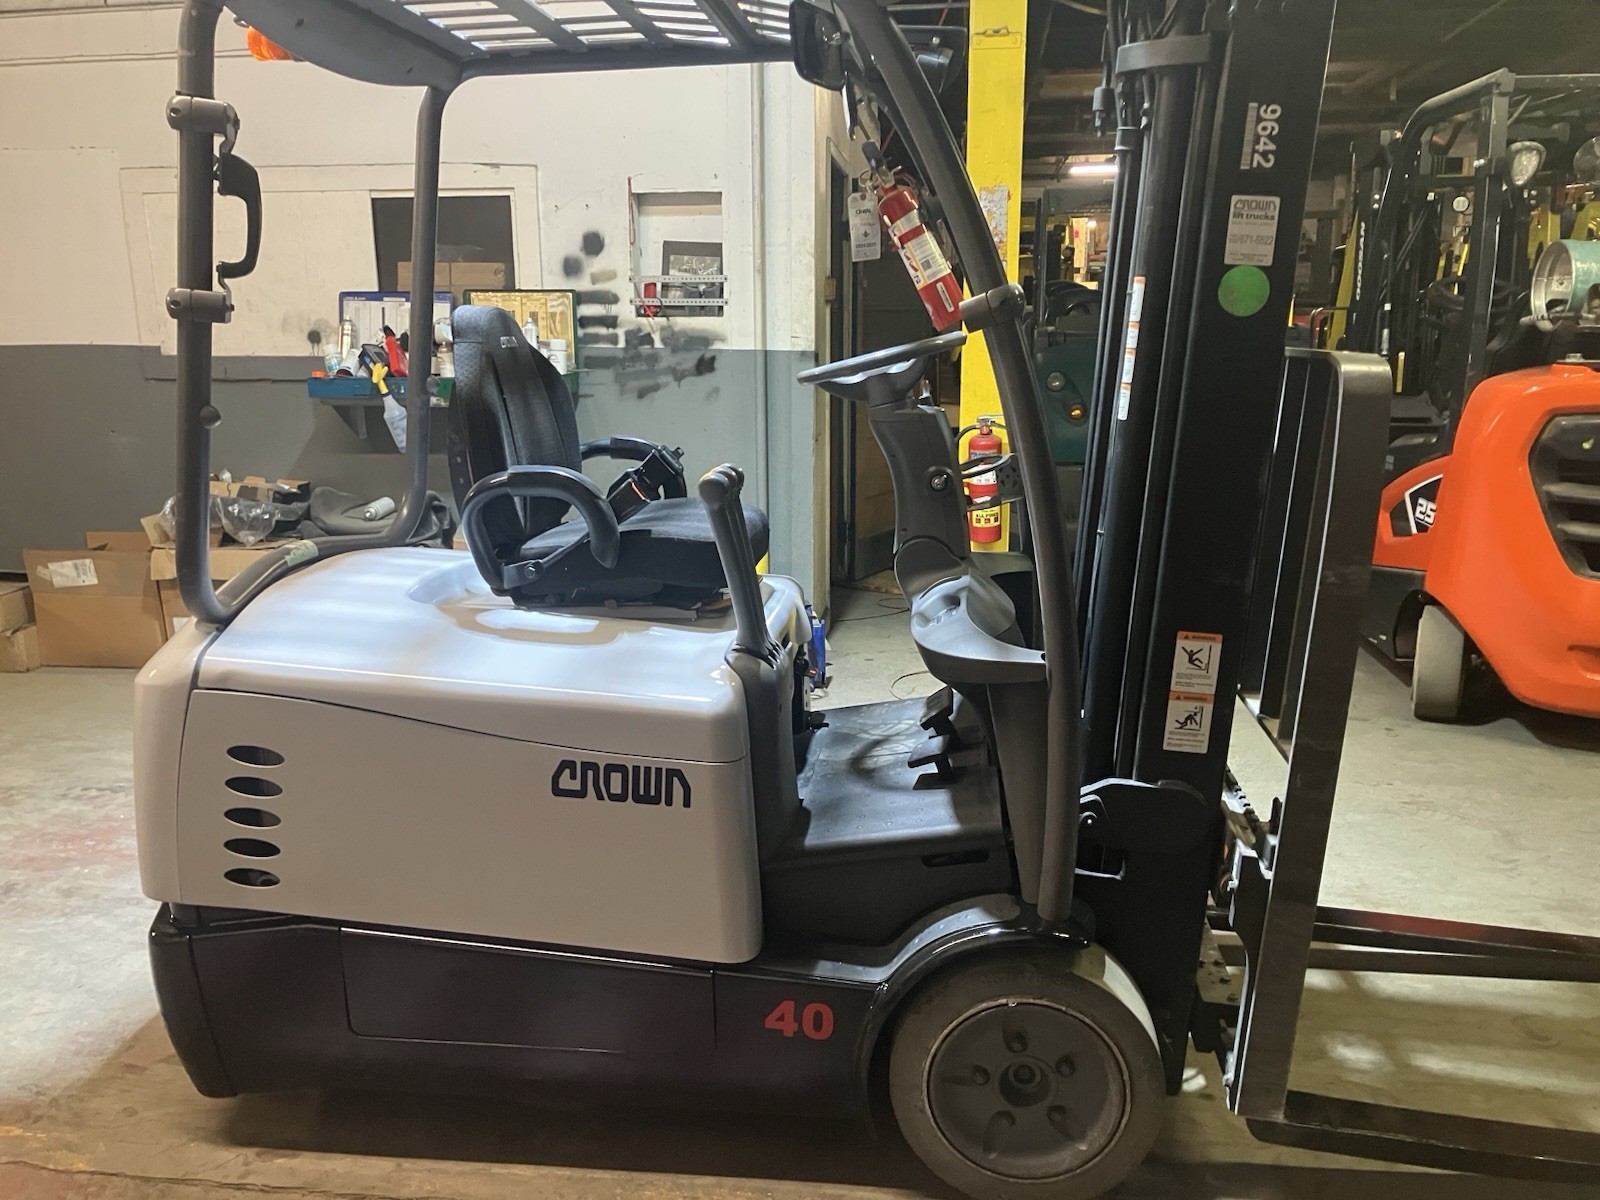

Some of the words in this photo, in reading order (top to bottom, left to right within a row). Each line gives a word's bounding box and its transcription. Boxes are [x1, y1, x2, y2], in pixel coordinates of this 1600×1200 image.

[1252, 103, 1282, 168] 9642
[1232, 211, 1244, 219] lift
[1245, 213, 1275, 221] trucks
[1233, 199, 1277, 212] CROWN
[1415, 497, 1437, 525] 25
[551, 759, 691, 808] CROWN
[764, 999, 834, 1040] 40
